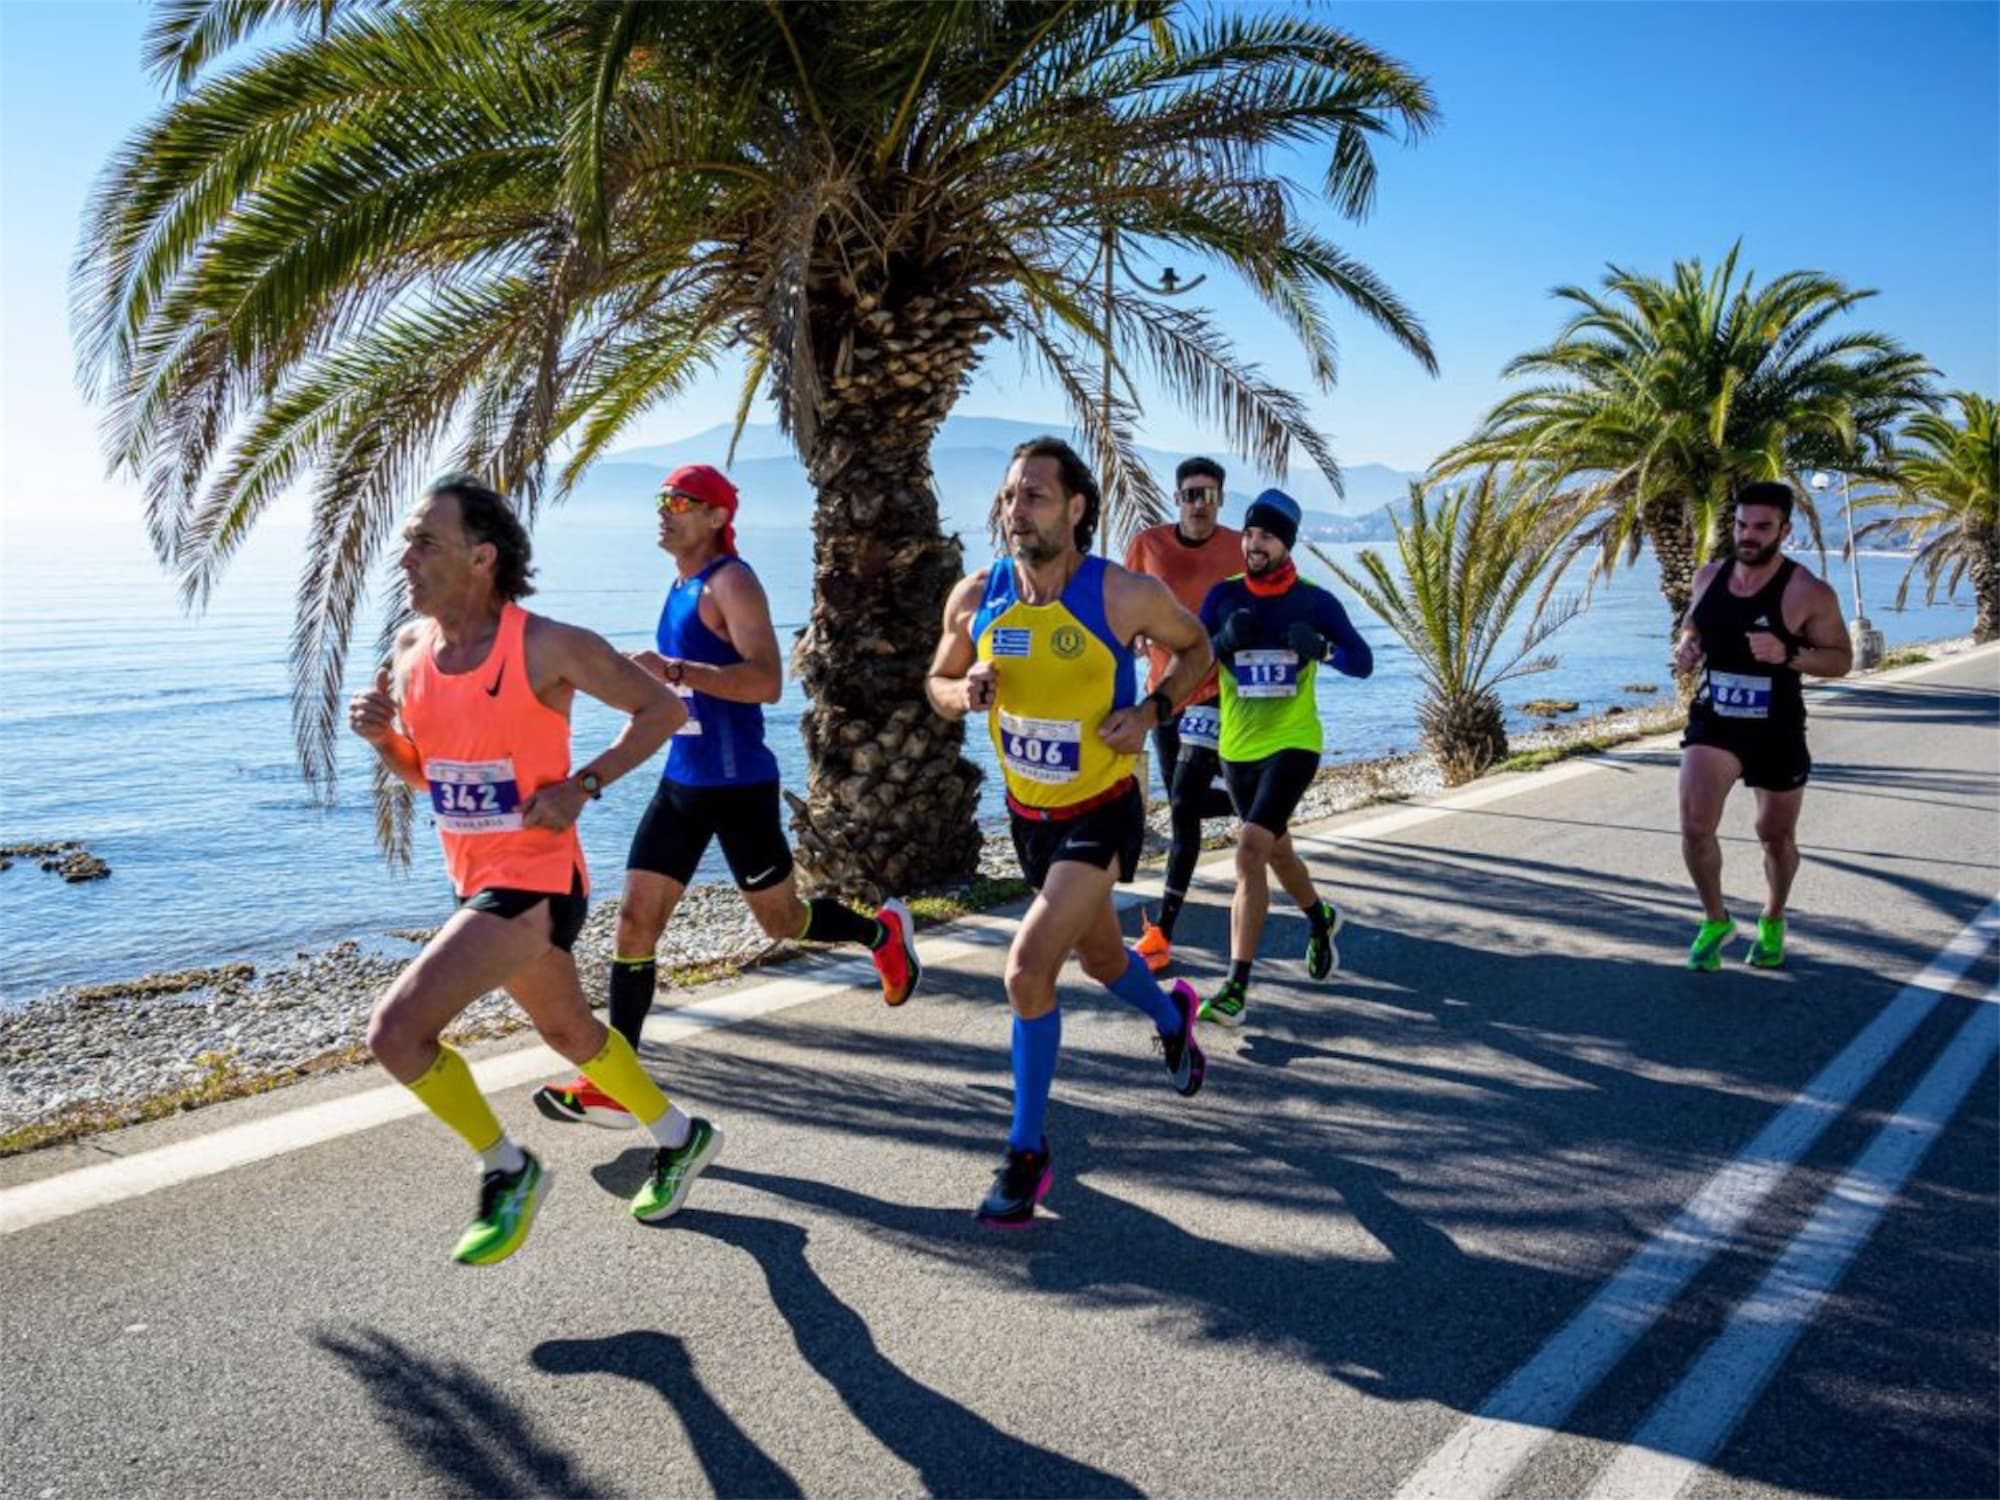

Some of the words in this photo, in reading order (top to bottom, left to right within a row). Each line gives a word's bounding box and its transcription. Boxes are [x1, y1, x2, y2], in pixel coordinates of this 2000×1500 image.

[1251, 666, 1286, 682] 113
[1717, 687, 1756, 705] 861
[1010, 736, 1063, 765] 606
[441, 783, 500, 810] 342
